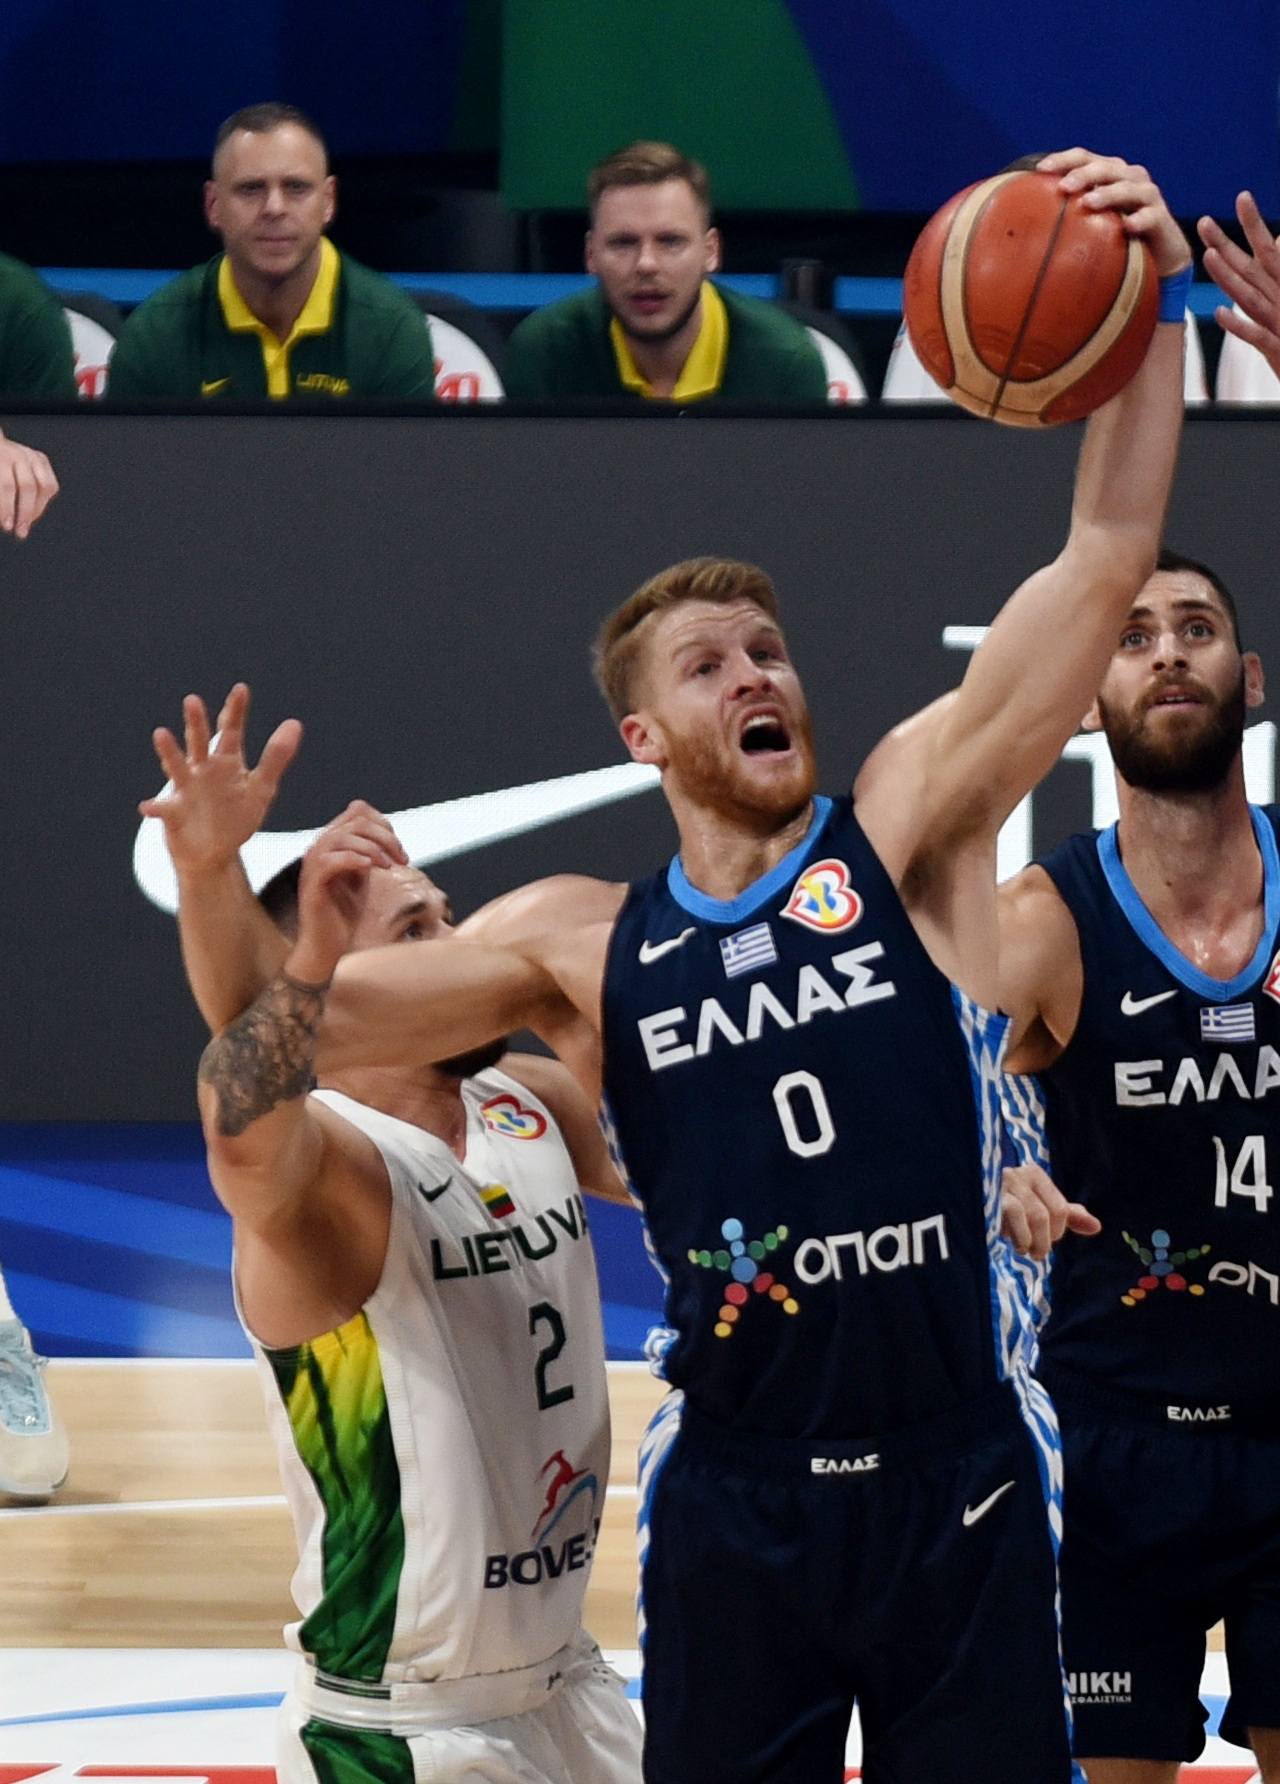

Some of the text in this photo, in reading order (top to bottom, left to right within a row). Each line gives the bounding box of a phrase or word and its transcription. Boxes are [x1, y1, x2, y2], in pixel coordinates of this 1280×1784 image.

[638, 940, 897, 1071] ΕΛΛΑΣ
[772, 1070, 836, 1158] 0
[1212, 1135, 1273, 1213] 14
[528, 1301, 575, 1411] 2
[1166, 1404, 1232, 1422] ΕΛΛΑΣ
[811, 1453, 880, 1473] ΕΛΛΑΣ
[1066, 1671, 1132, 1694] ΝΙΚΗ
